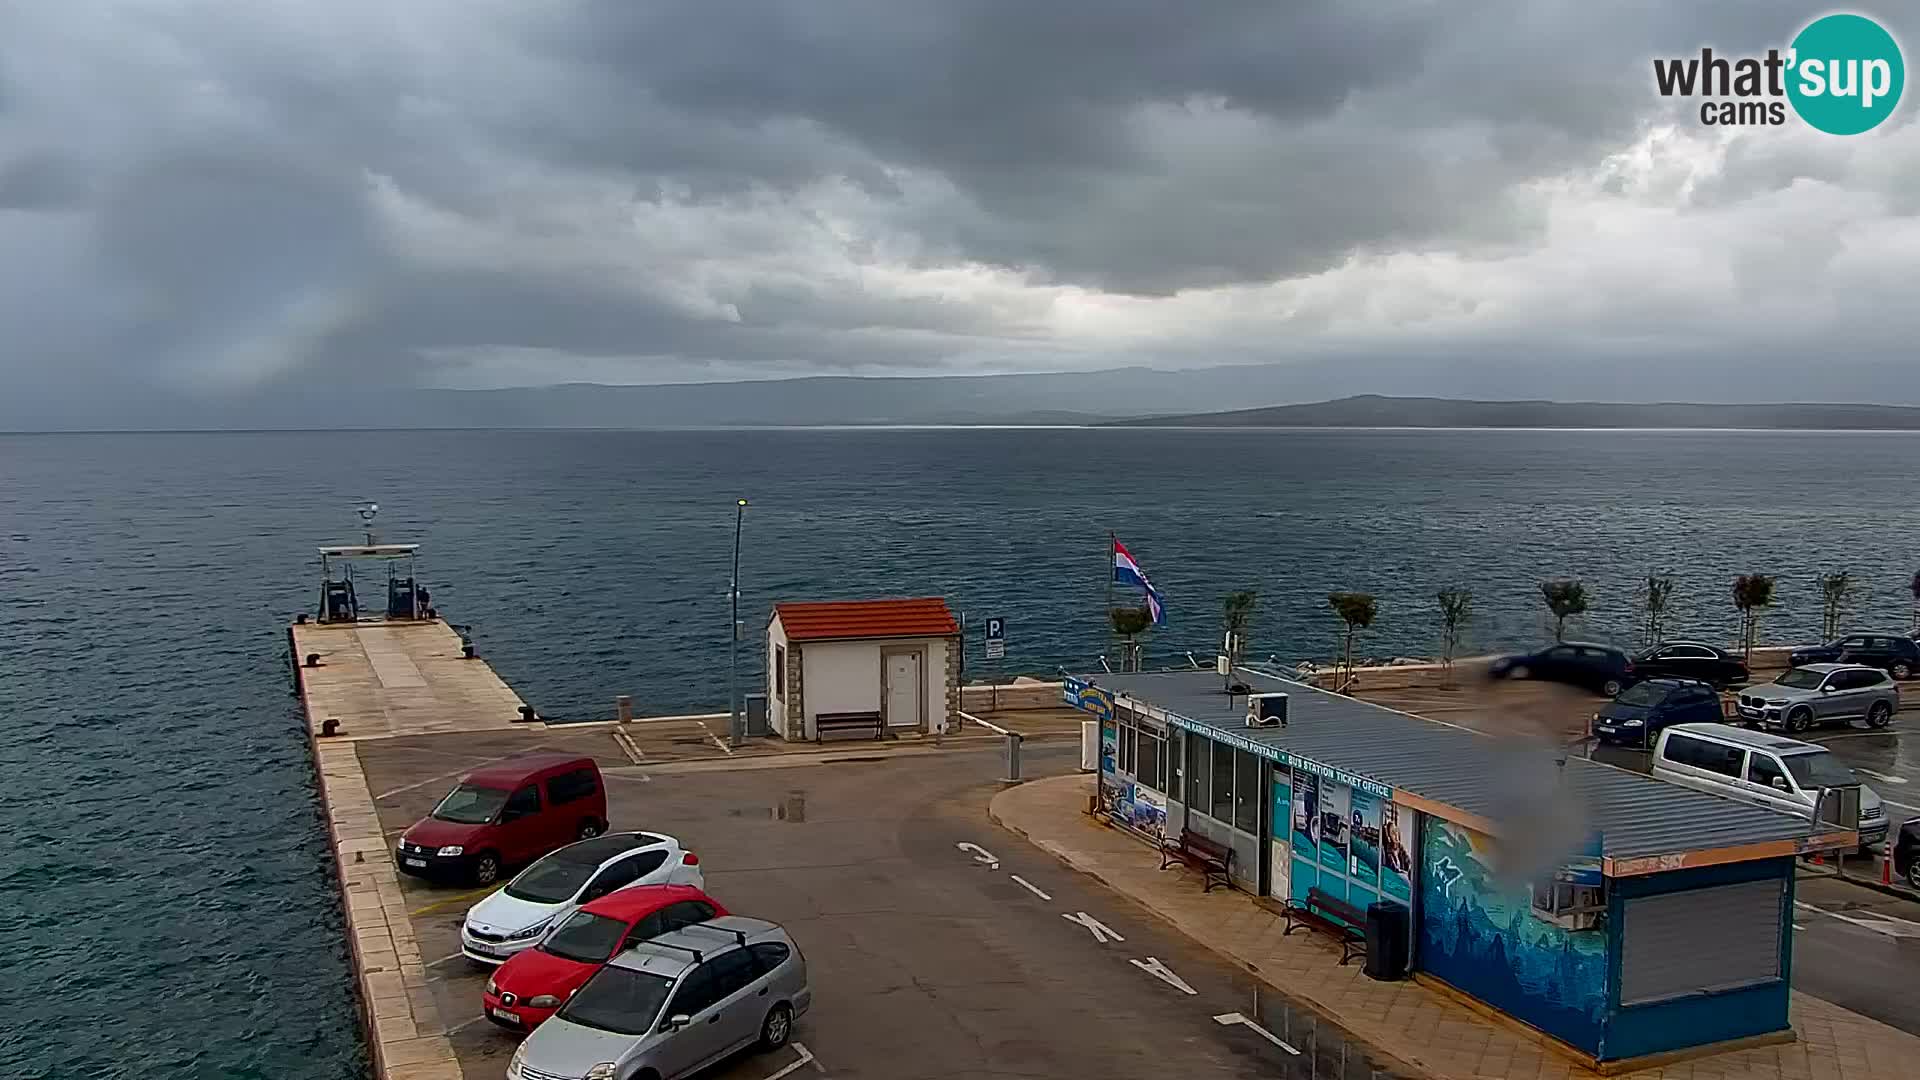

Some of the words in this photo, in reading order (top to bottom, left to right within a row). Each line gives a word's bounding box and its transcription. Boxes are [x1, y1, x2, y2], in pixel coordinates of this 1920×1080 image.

[990, 620, 1000, 637] P
[1249, 745, 1278, 760] POSTAJA
[1288, 754, 1302, 767] BUS
[1303, 762, 1334, 778] STATION
[1336, 772, 1361, 788] TICKET
[1362, 780, 1388, 797] OFFICE
